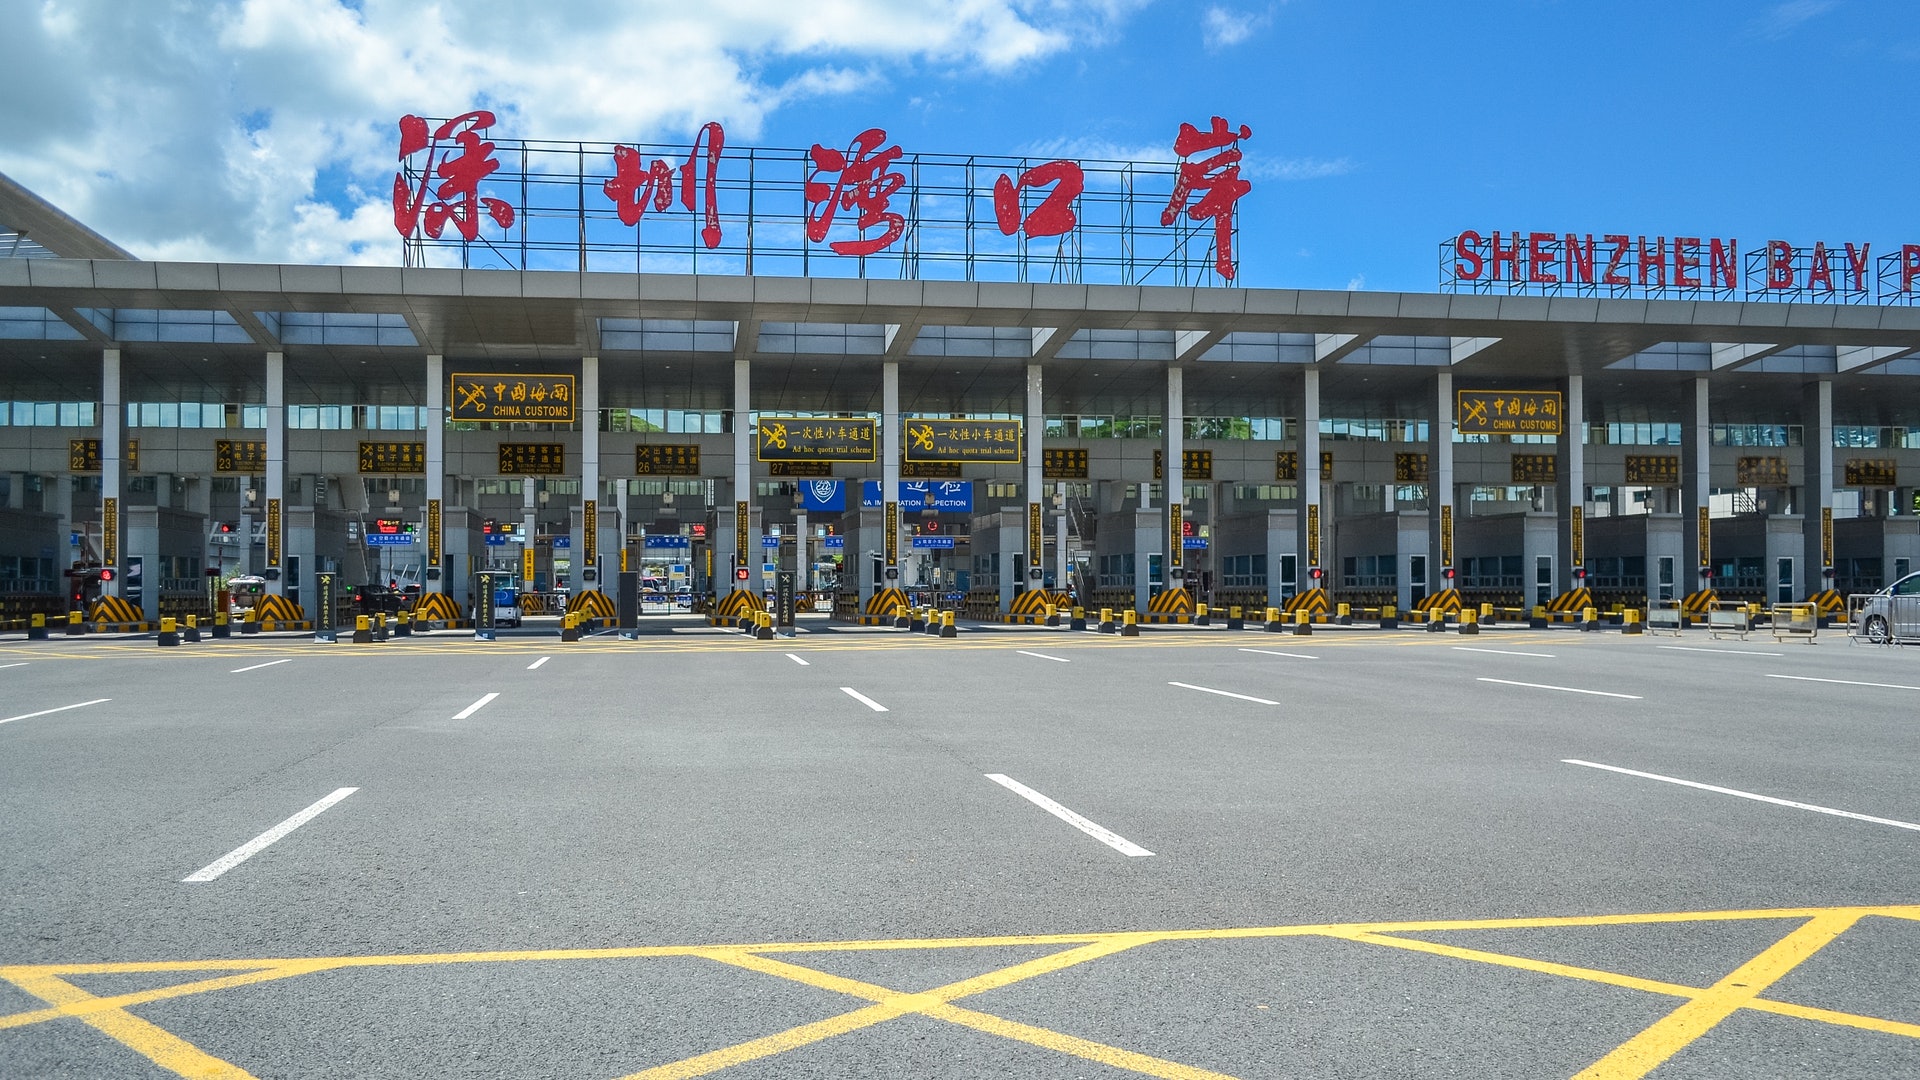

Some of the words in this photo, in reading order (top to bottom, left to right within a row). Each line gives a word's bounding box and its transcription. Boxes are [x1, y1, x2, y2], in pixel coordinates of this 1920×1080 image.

[394, 110, 1252, 282] 深圳湾口岸
[1456, 230, 1737, 288] SHENZHEN
[1767, 240, 1870, 291] BAY
[493, 405, 521, 416] CHINA
[525, 406, 568, 416] CUSTOMS
[1493, 419, 1516, 429] CHINA
[1520, 420, 1557, 430] CUSTOMS
[790, 426, 871, 441] 一次性小车通道
[937, 428, 1016, 442] 一次性小车通道
[792, 445, 801, 453] Ad
[803, 445, 814, 453] hoc
[817, 446, 834, 455] quota
[962, 447, 978, 456] quota
[72, 457, 85, 468] 22
[219, 458, 231, 470] 23
[361, 459, 373, 470] 24
[501, 460, 513, 472] 25
[638, 462, 650, 473] 26
[772, 463, 783, 474] 27
[903, 464, 914, 475] 28
[1278, 468, 1288, 478] 31
[1397, 468, 1408, 479] 32
[1514, 470, 1525, 480] 33
[1627, 471, 1638, 481] 34
